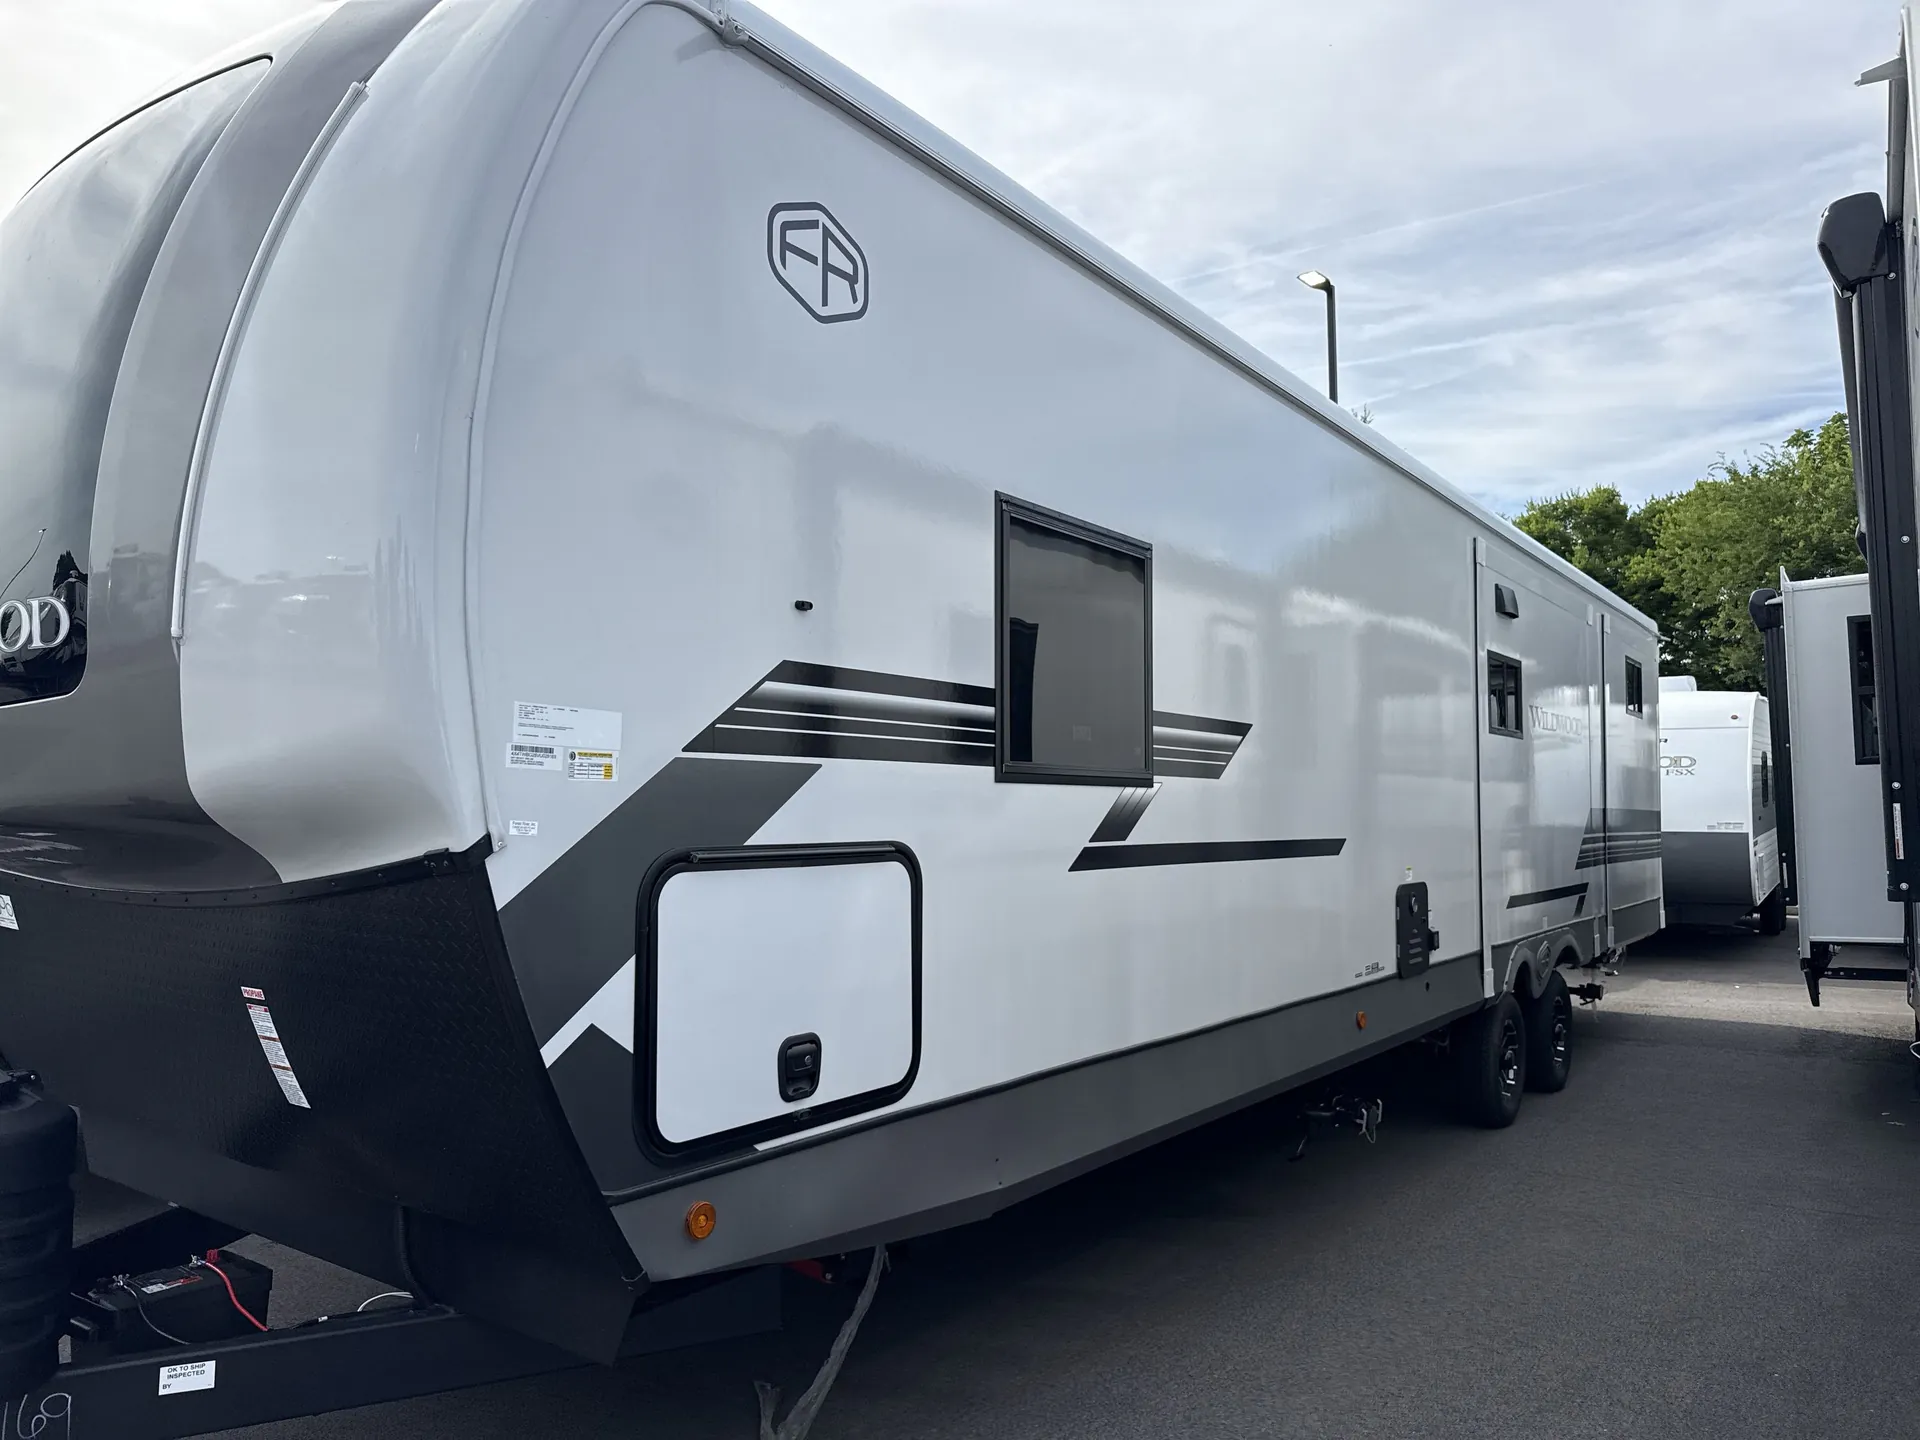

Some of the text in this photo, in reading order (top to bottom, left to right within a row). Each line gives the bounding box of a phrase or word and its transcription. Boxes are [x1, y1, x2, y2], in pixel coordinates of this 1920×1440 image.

[779, 219, 859, 307] FR
[1665, 768, 1696, 776] FSX
[167, 1369, 206, 1380] INSPECTED
